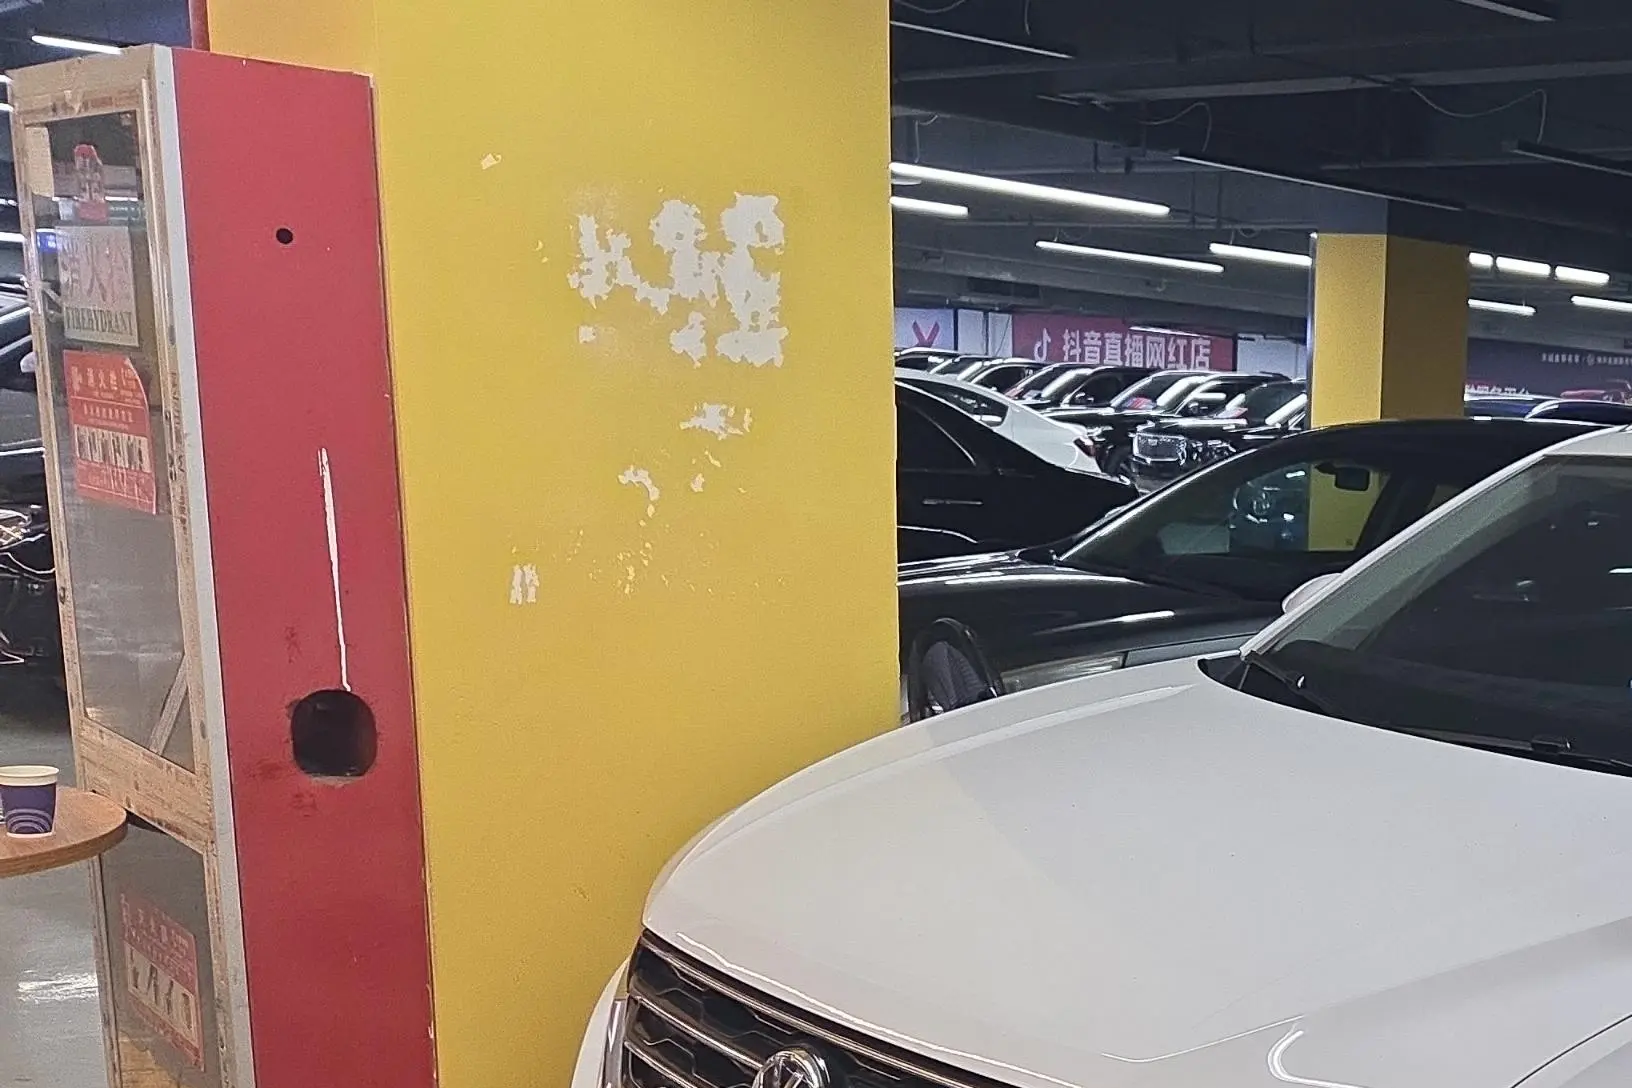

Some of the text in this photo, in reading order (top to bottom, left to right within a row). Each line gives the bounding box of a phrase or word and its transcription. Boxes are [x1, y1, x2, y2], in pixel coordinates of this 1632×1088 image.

[1061, 328, 1212, 372] 抖音直播网红店
